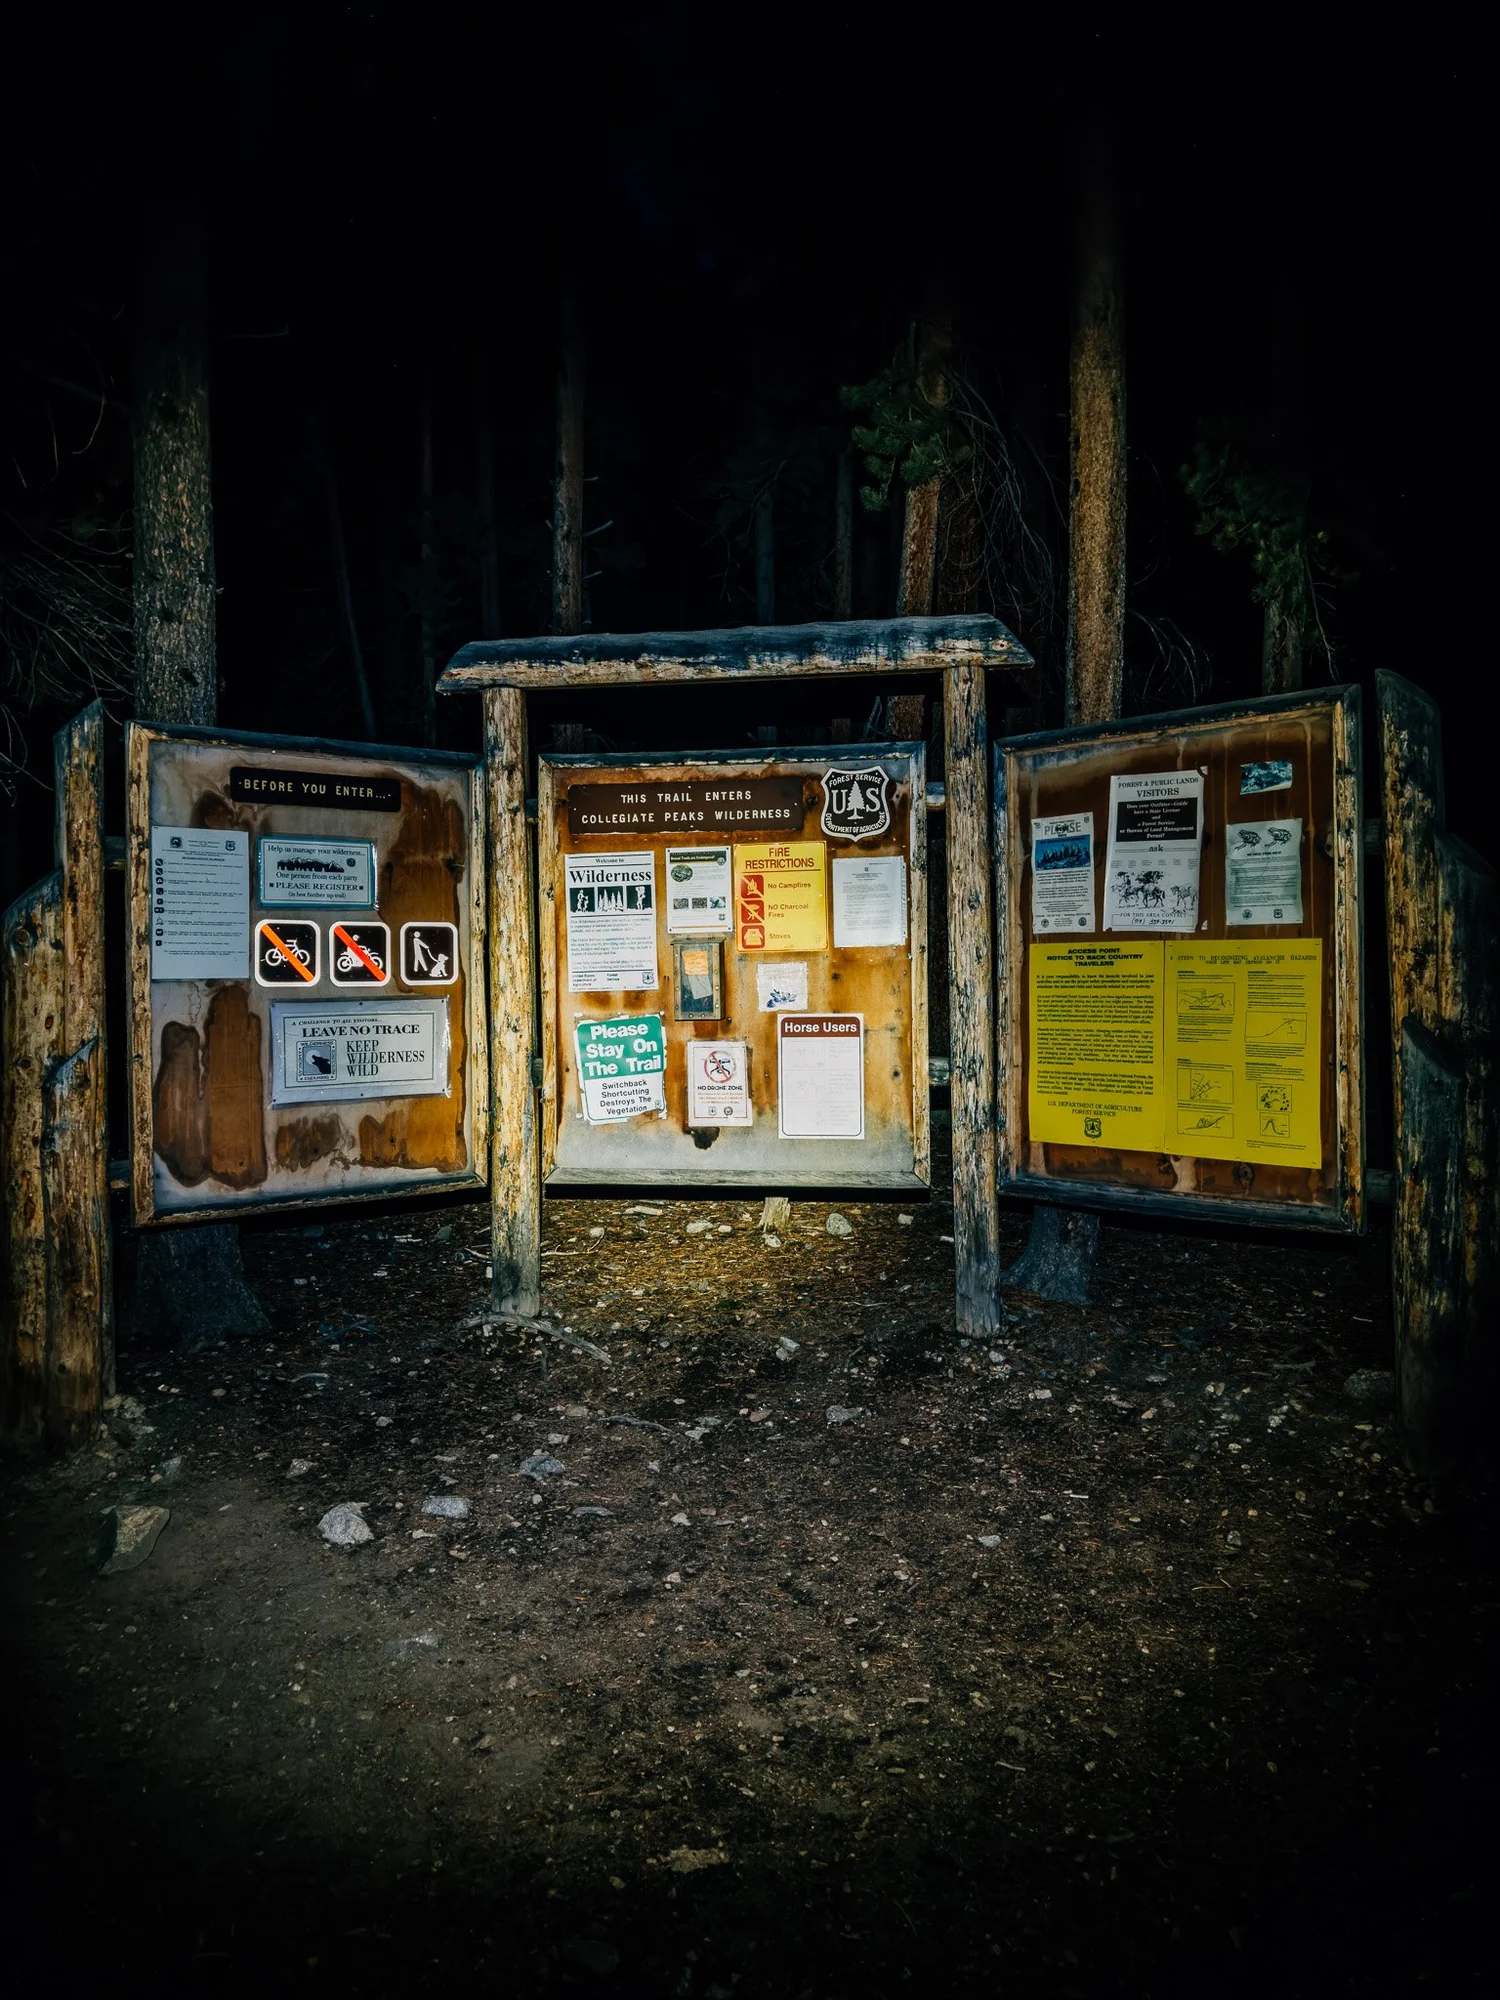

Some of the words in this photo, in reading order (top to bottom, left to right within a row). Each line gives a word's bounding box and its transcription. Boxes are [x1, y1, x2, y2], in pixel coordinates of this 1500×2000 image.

[244, 779, 293, 792] BEFORE
[302, 783, 326, 794] YOU
[829, 775, 853, 787] FOREST
[855, 774, 881, 784] SERVICE
[621, 795, 646, 804] THIS
[658, 793, 692, 802] TRAIL
[706, 791, 752, 801] ENTERS
[1137, 788, 1179, 797] VISITORS
[582, 813, 654, 824] COLLEGIATE
[665, 812, 704, 821] PEAKS
[715, 809, 790, 820] WILDERNESS
[826, 813, 852, 832] DEPARTMENT
[859, 811, 885, 832] AGRICULTURE
[268, 845, 283, 853] Help
[769, 847, 790, 857] FIRE
[746, 858, 814, 869] RESTRICTIONS
[570, 870, 651, 883] Wilderness
[313, 883, 358, 891] REGISTER
[302, 1027, 347, 1037] LEAVE
[350, 1026, 370, 1035] NO
[372, 1024, 419, 1034] TRACE
[590, 1024, 648, 1040] Please
[785, 1022, 819, 1033] Horse
[823, 1022, 857, 1032] Users
[347, 1040, 379, 1052] KEEP
[586, 1043, 624, 1059] Stay
[633, 1039, 657, 1053] On
[347, 1050, 424, 1065] WILDERNESS
[347, 1064, 378, 1077] WILD
[585, 1062, 618, 1076] The
[626, 1055, 661, 1072] Trail
[602, 1080, 647, 1089] Switchback
[602, 1088, 649, 1098] Shortcutting
[600, 1099, 635, 1107] Destroys
[1103, 1104, 1142, 1112] AGRICULTURE
[607, 1106, 647, 1115] Vegetation
